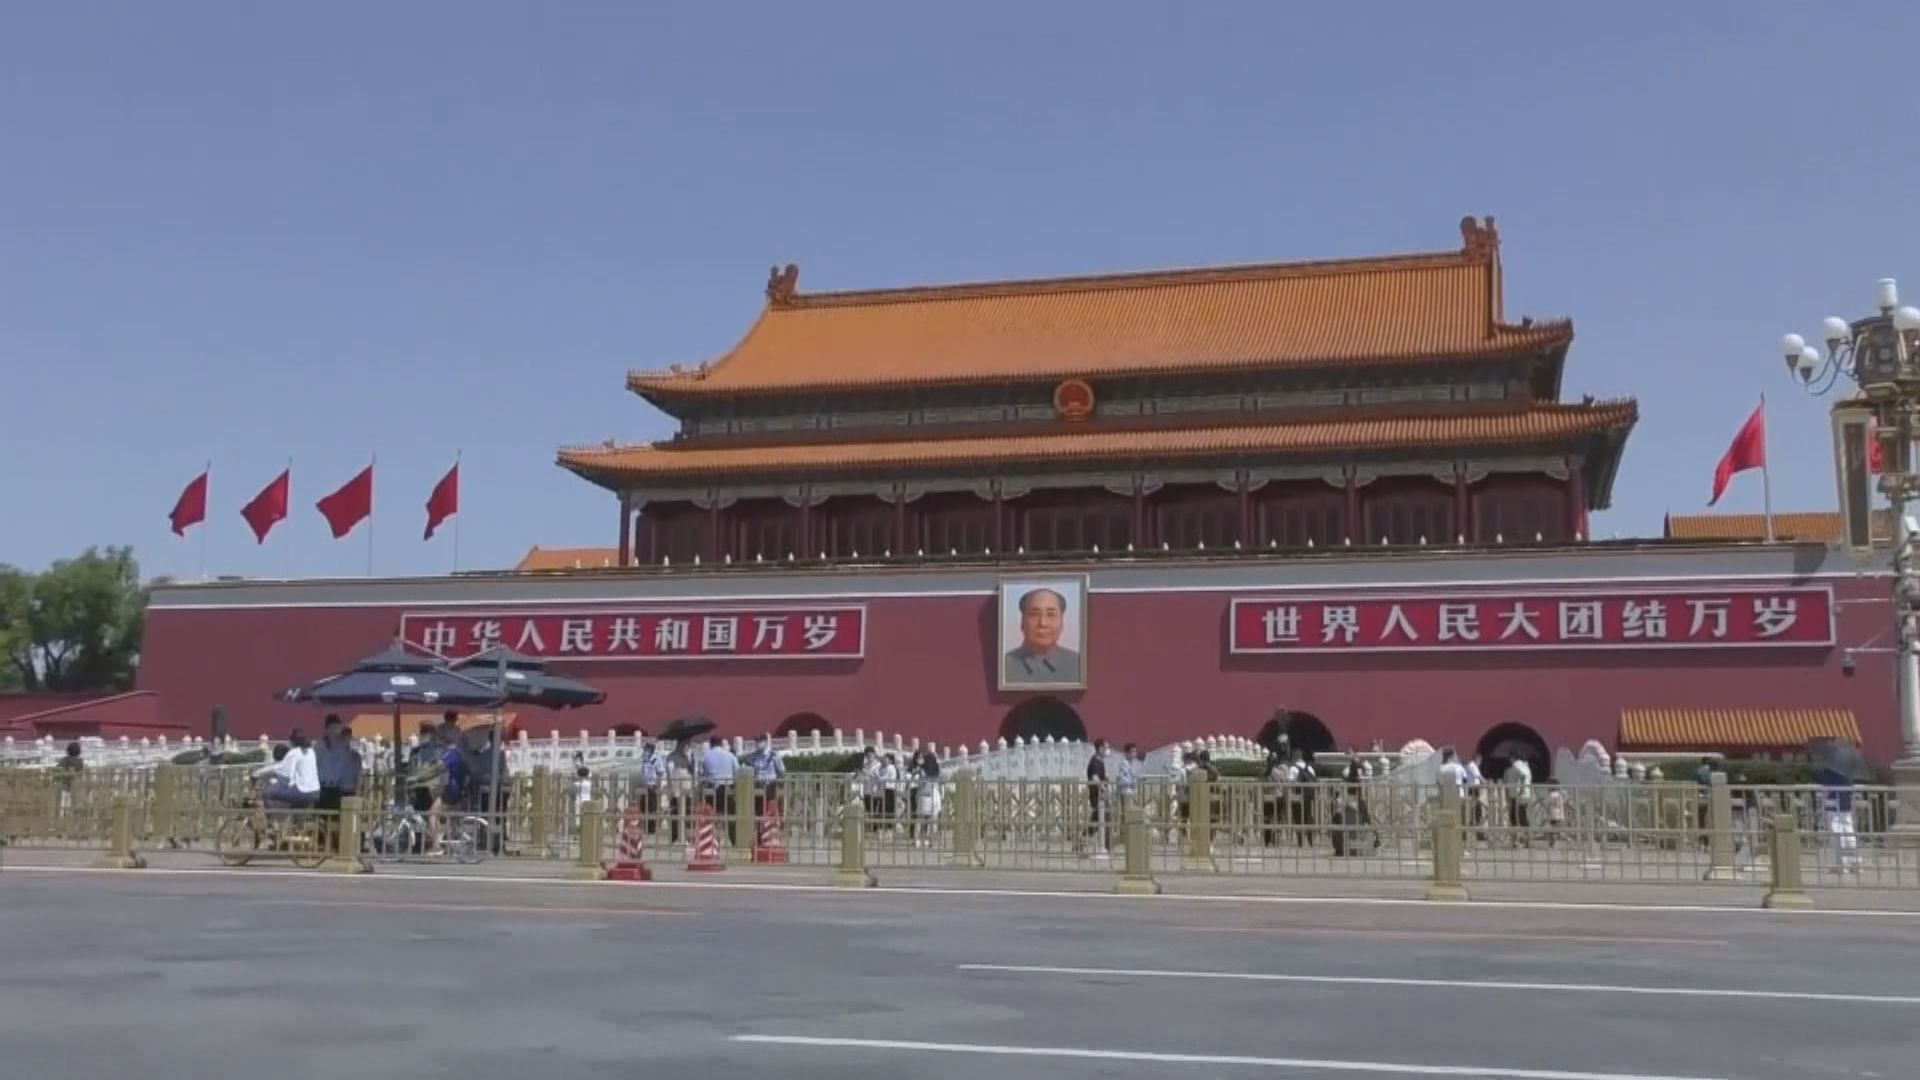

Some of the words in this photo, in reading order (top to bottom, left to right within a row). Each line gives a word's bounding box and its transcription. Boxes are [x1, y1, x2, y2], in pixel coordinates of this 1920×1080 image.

[423, 615, 839, 654] 中华人民共和国万岁
[1262, 597, 1798, 643] 世界人民大团结万岁
